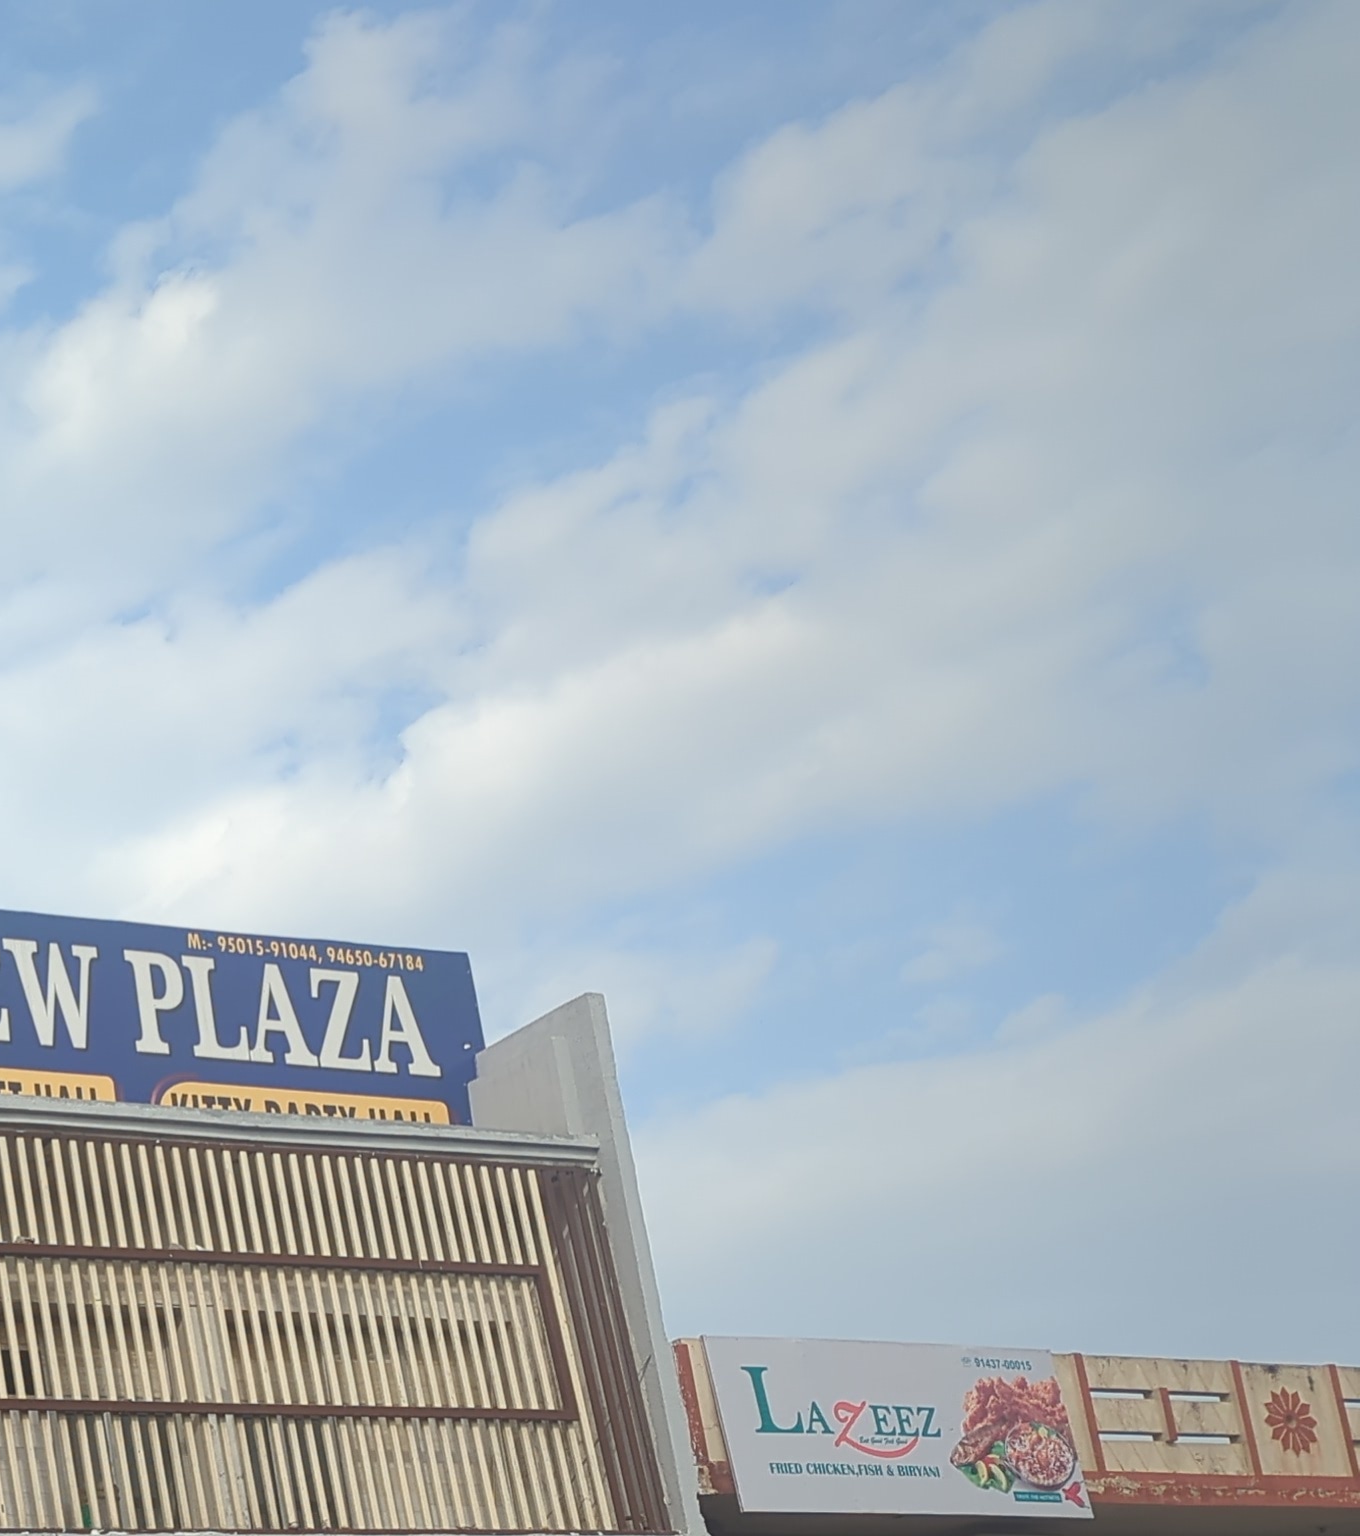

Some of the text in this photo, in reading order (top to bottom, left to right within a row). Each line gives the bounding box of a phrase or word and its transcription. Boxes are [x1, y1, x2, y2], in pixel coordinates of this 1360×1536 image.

[217, 936, 323, 965] 95015-91044,
[326, 949, 424, 972] 94650-67184
[123, 950, 443, 1078] PLAZA
[974, 1356, 1032, 1371] 91437-00015
[741, 1366, 941, 1458] LAZEEZ
[769, 1462, 803, 1475] FRIED
[887, 1466, 895, 1476] &
[897, 1466, 941, 1478] BIRYANI
